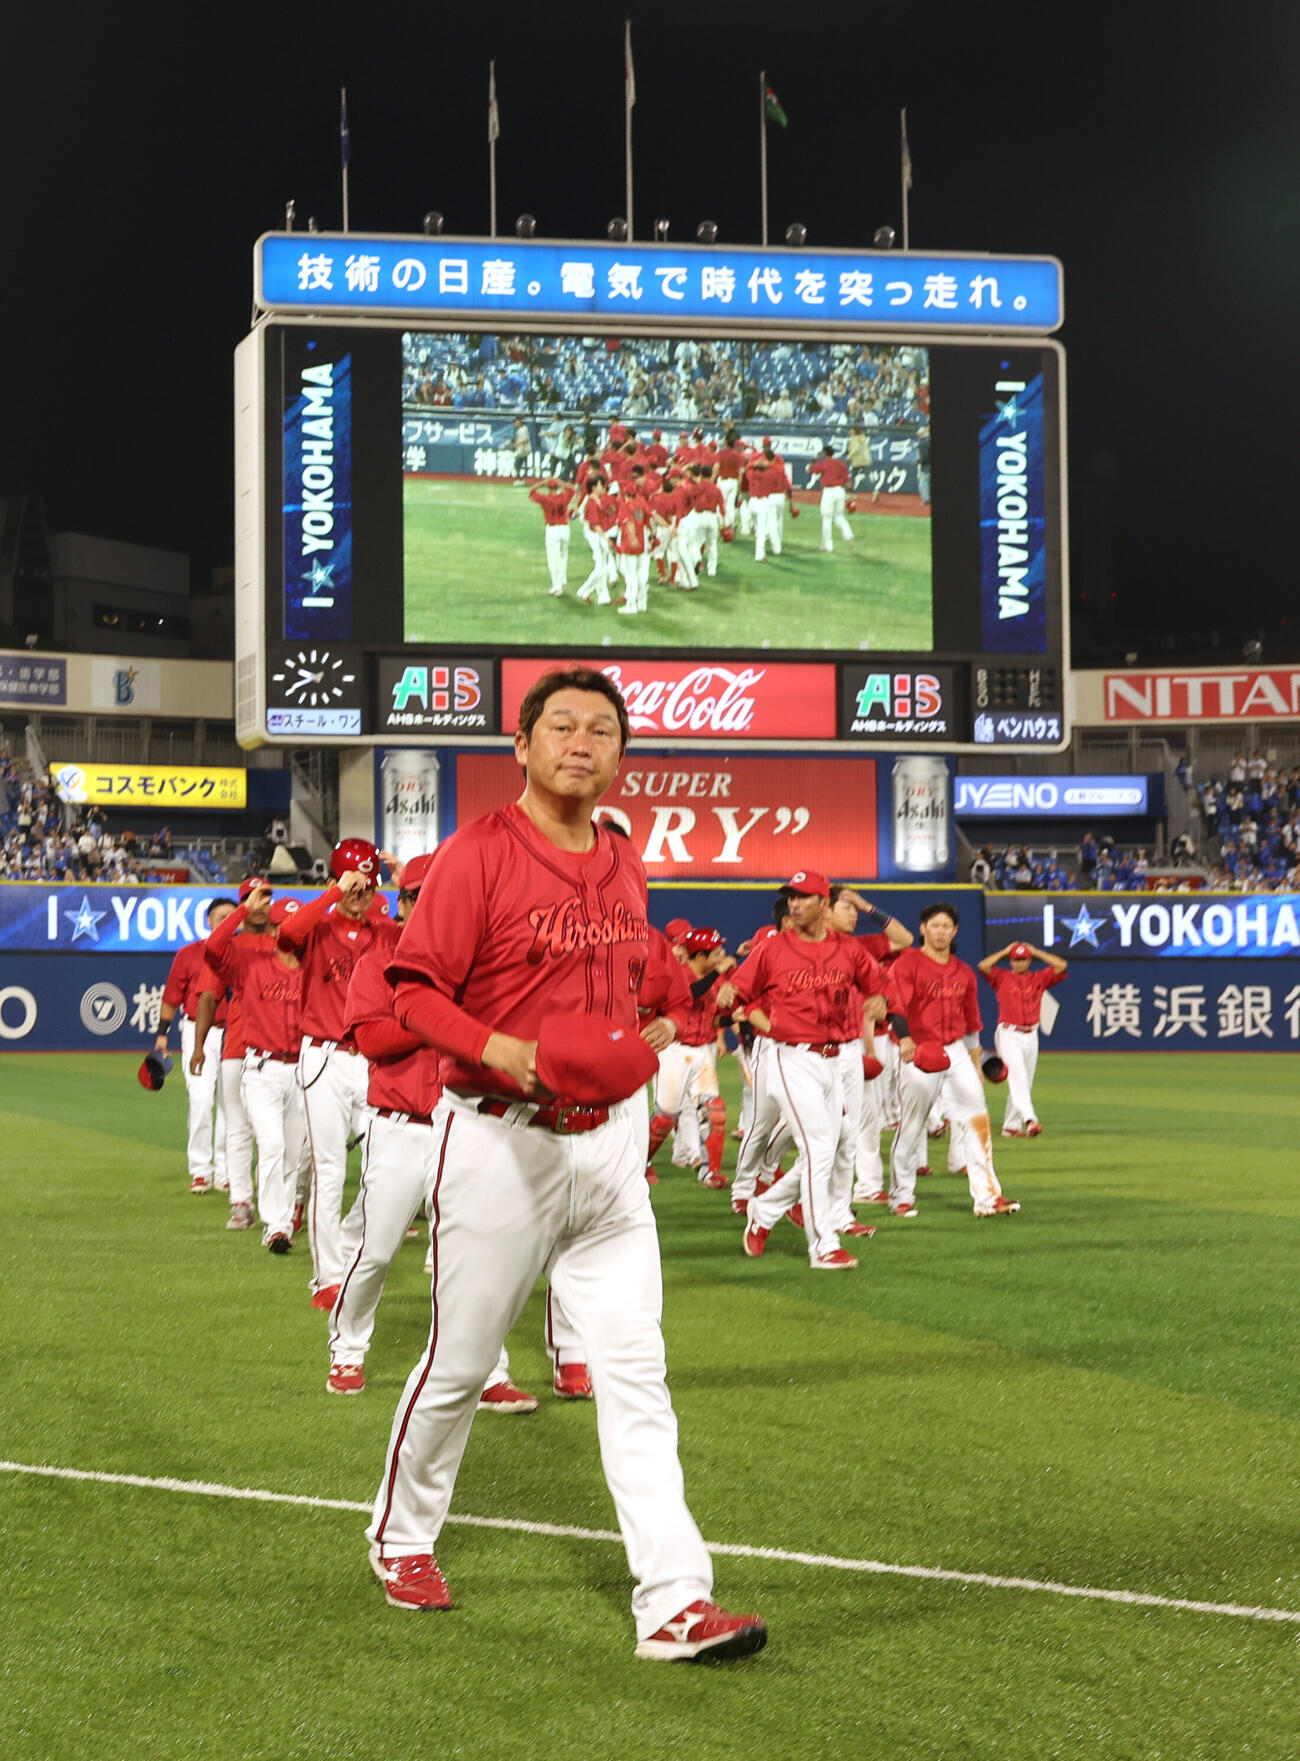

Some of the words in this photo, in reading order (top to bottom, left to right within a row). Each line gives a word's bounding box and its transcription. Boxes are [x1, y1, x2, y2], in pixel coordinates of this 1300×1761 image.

[297, 252, 1028, 311] 技術の日産。電気で時代を突っ走れ。
[402, 420, 493, 446] フサービス
[301, 363, 334, 556] YOKOHAMA
[996, 431, 1029, 619] YOKOHAMA
[601, 666, 766, 731] ca-Cola
[96, 775, 216, 798] コスモバンク
[386, 792, 436, 815] Asahi
[620, 771, 732, 797] SUPER
[897, 798, 946, 819] Asahi
[48, 895, 57, 940] I
[527, 897, 648, 966] Hiroshim
[1043, 904, 1054, 947] I
[1111, 903, 1300, 947] YOKOHA
